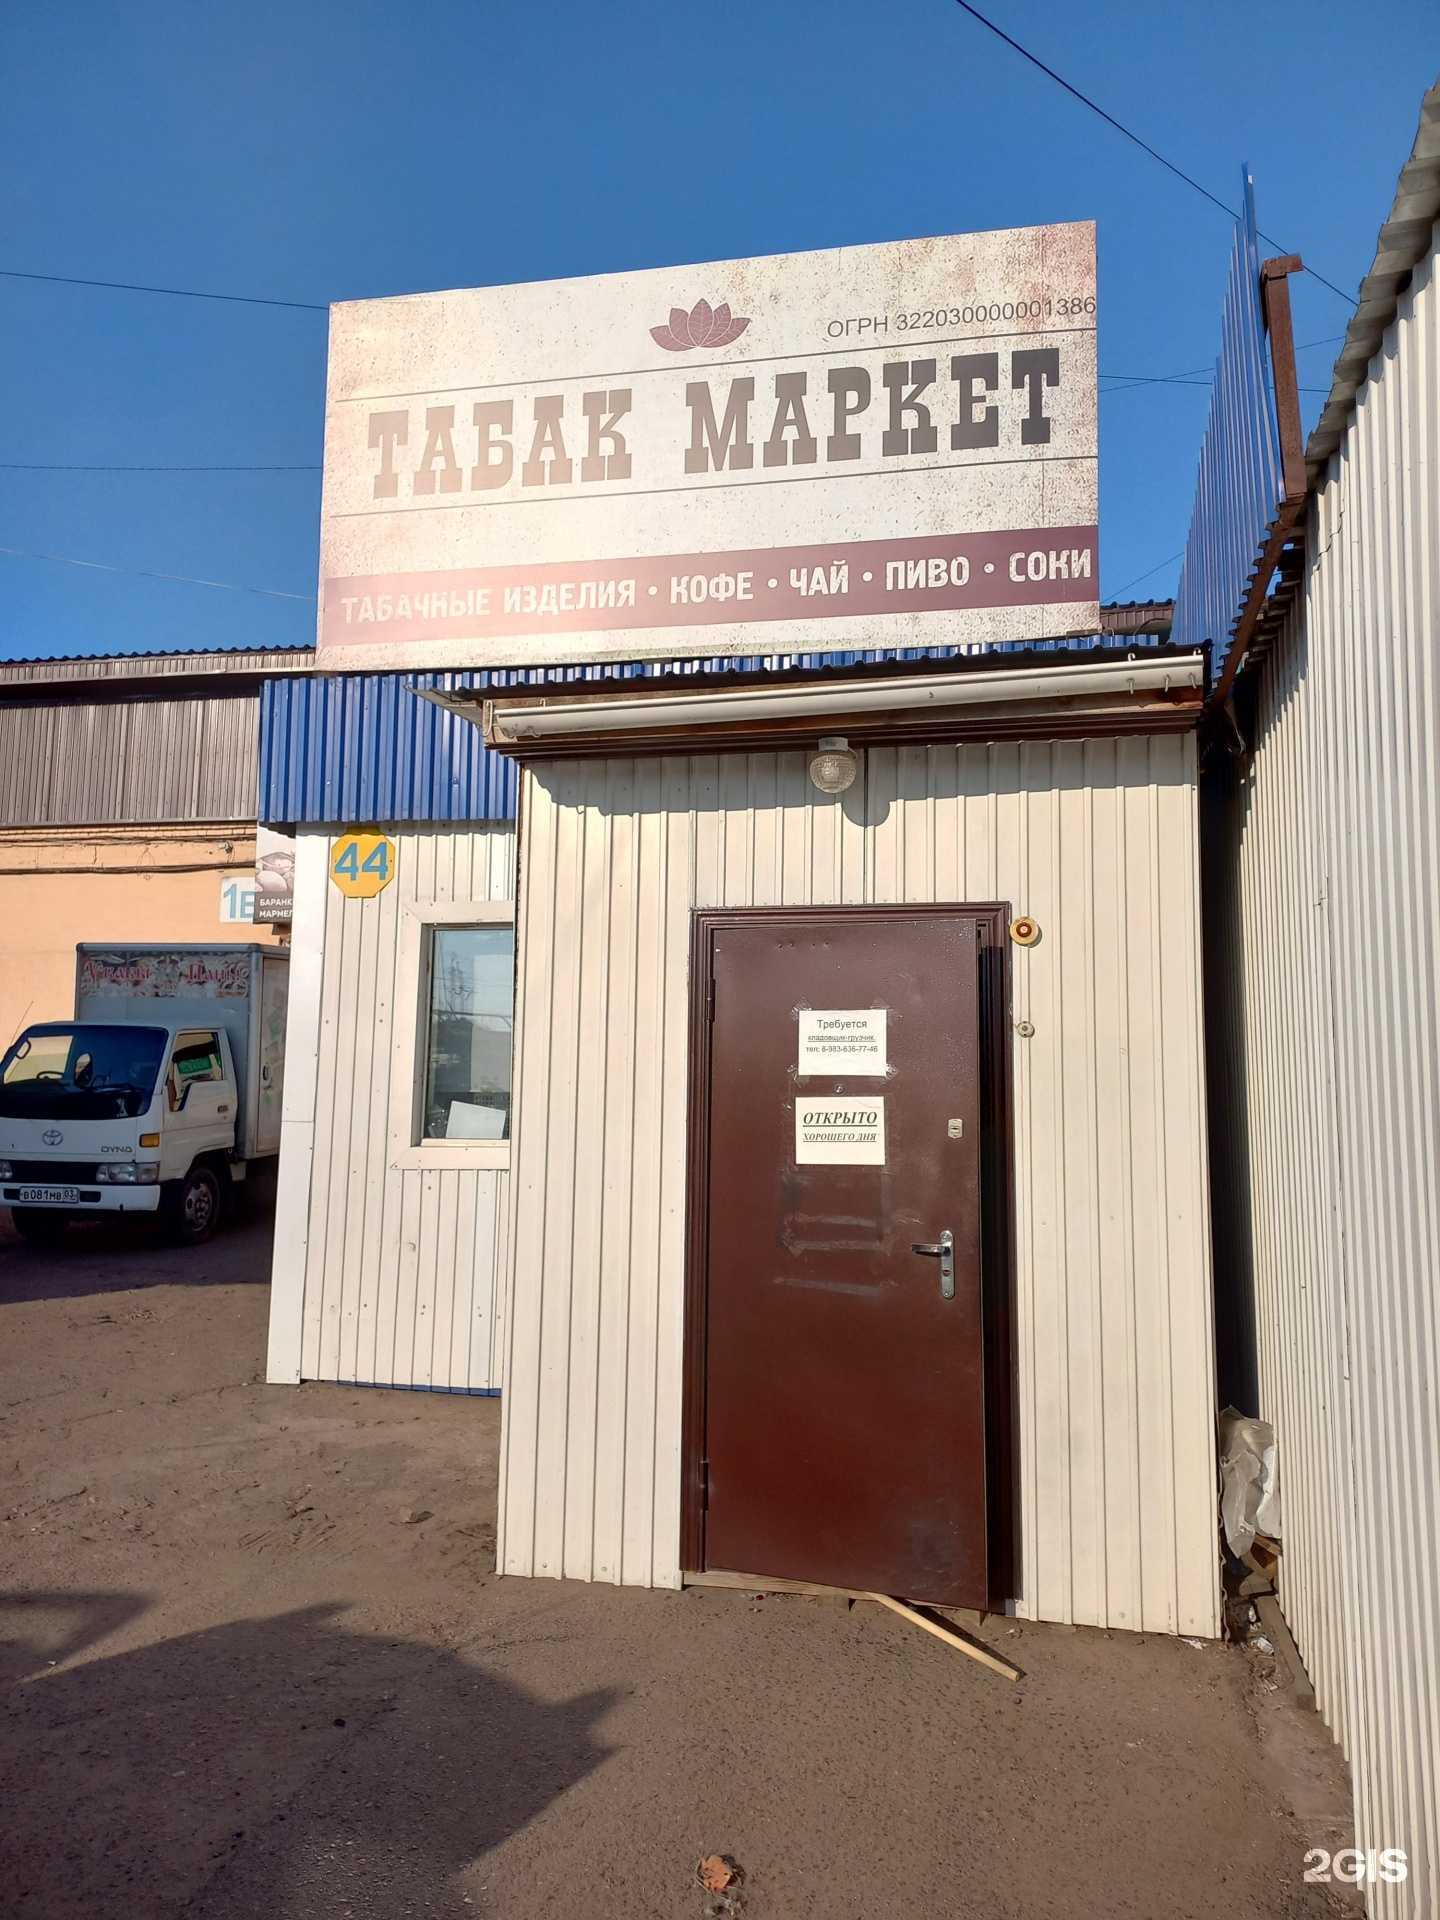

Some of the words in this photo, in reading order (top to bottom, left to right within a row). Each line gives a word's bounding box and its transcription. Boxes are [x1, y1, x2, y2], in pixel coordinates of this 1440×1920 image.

[827, 315, 888, 338] ОГРН
[896, 296, 1096, 331] 322030000001386
[368, 388, 632, 499] ТАБАК
[684, 348, 1060, 474] МАРКЕТ
[340, 588, 491, 624] ТАБАЧНЫЕ
[503, 579, 636, 615] ИЗДЕЛИЯ
[669, 571, 754, 604] КОФЕ
[789, 560, 849, 596] ЧАЙ
[885, 556, 970, 590] ПИВО
[1008, 549, 1092, 583] СОКИ
[334, 842, 389, 881] 44
[817, 1019, 867, 1030] Требуется
[803, 1112, 878, 1124] ОТКРЫТО
[804, 1133, 855, 1141] ХОРОШЕГО
[857, 1133, 877, 1141] ДНЯ
